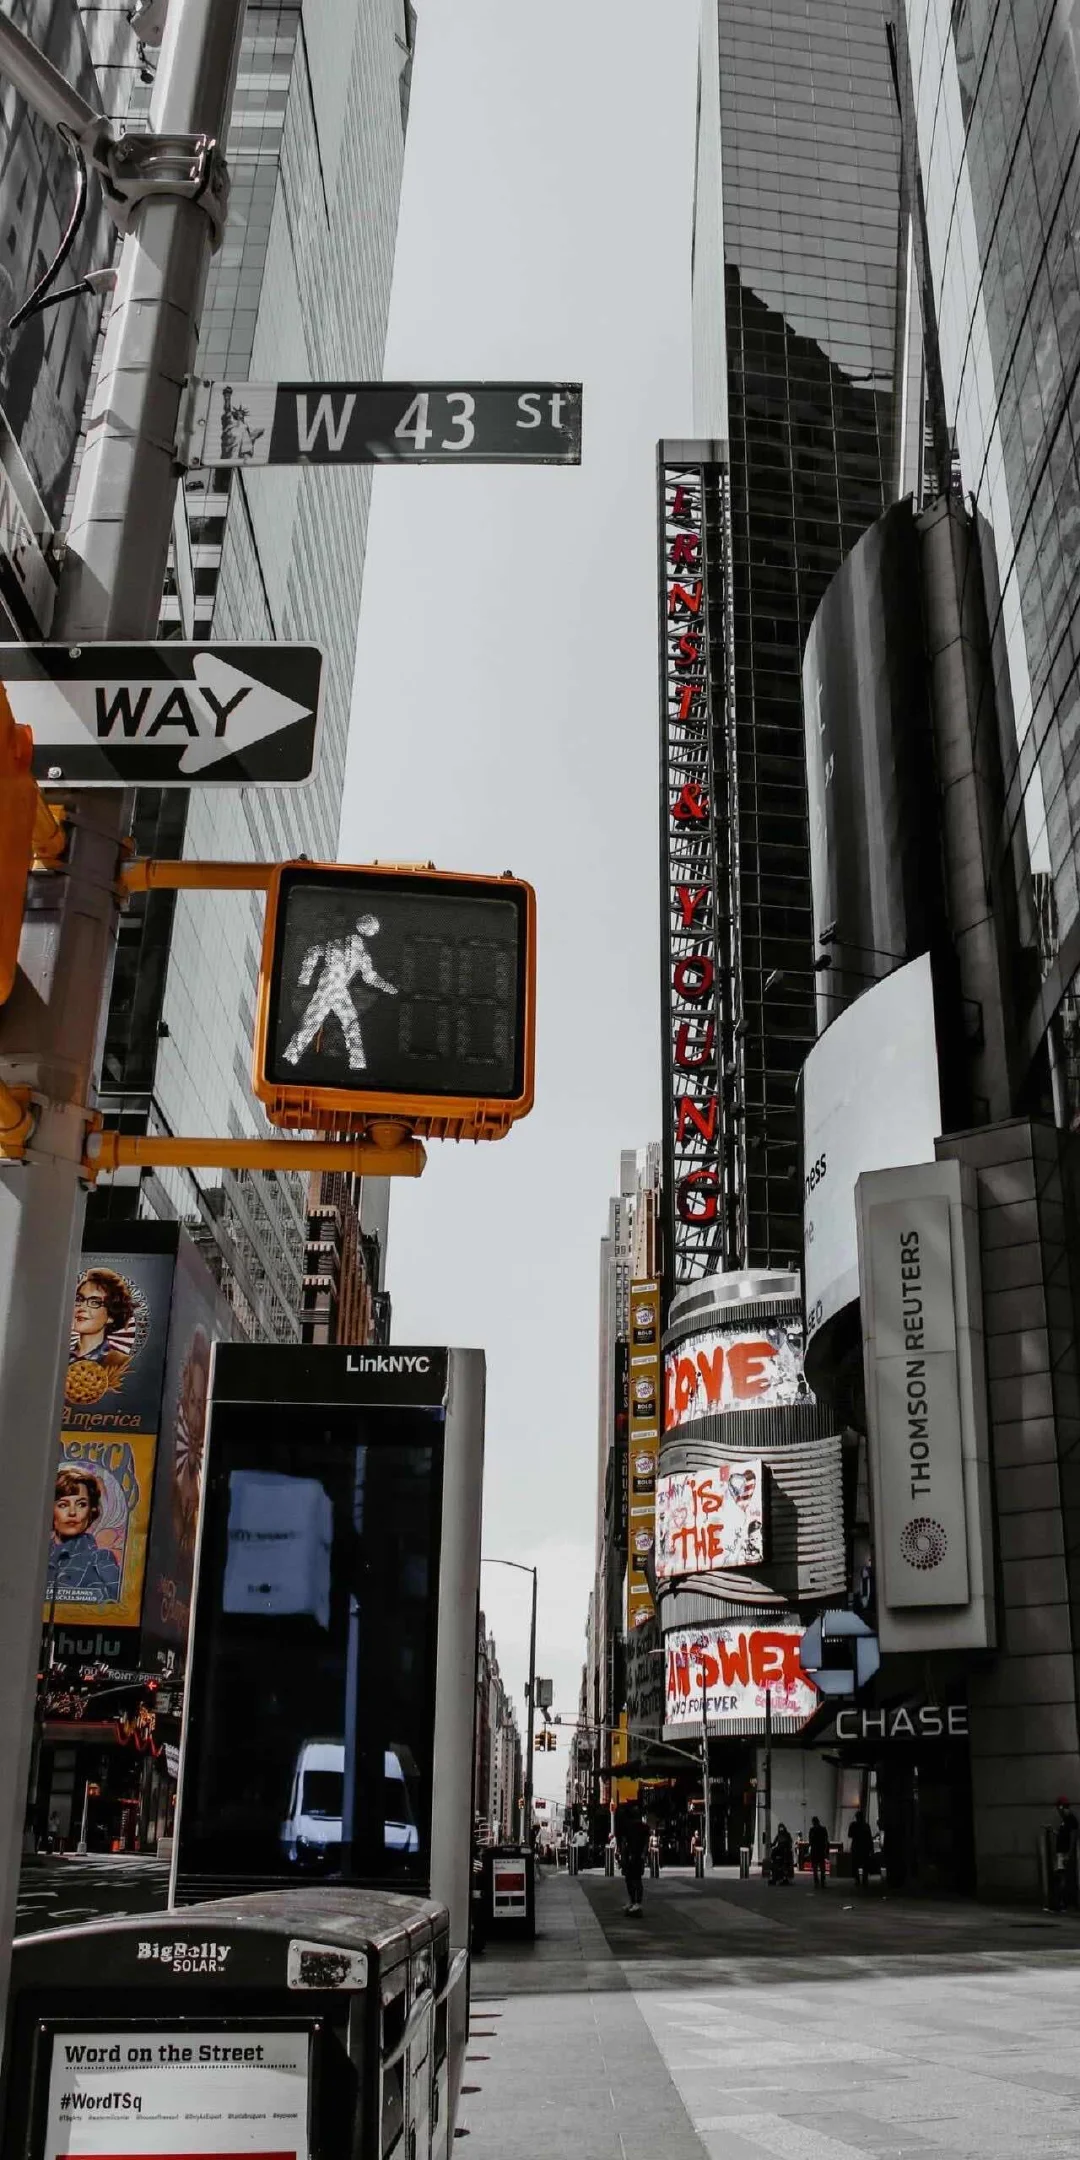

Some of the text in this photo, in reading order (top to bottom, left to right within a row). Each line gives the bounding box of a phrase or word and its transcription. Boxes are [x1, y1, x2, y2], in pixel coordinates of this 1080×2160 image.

[296, 392, 566, 451] W 43 St
[95, 687, 253, 737] WAY
[673, 784, 708, 820] &
[673, 886, 720, 1222] YOUNG
[346, 1354, 430, 1373] LinkNYC
[900, 1231, 931, 1500] THOMSON REUTERS
[670, 1523, 724, 1563] THE
[58, 1631, 121, 1656] hulu
[836, 1705, 969, 1739] CHASE
[137, 1942, 232, 1963] BigBelly
[173, 1959, 217, 1972] SOLAR
[65, 2044, 264, 2063] Word on the Street
[60, 2092, 142, 2113] #WordTSq
